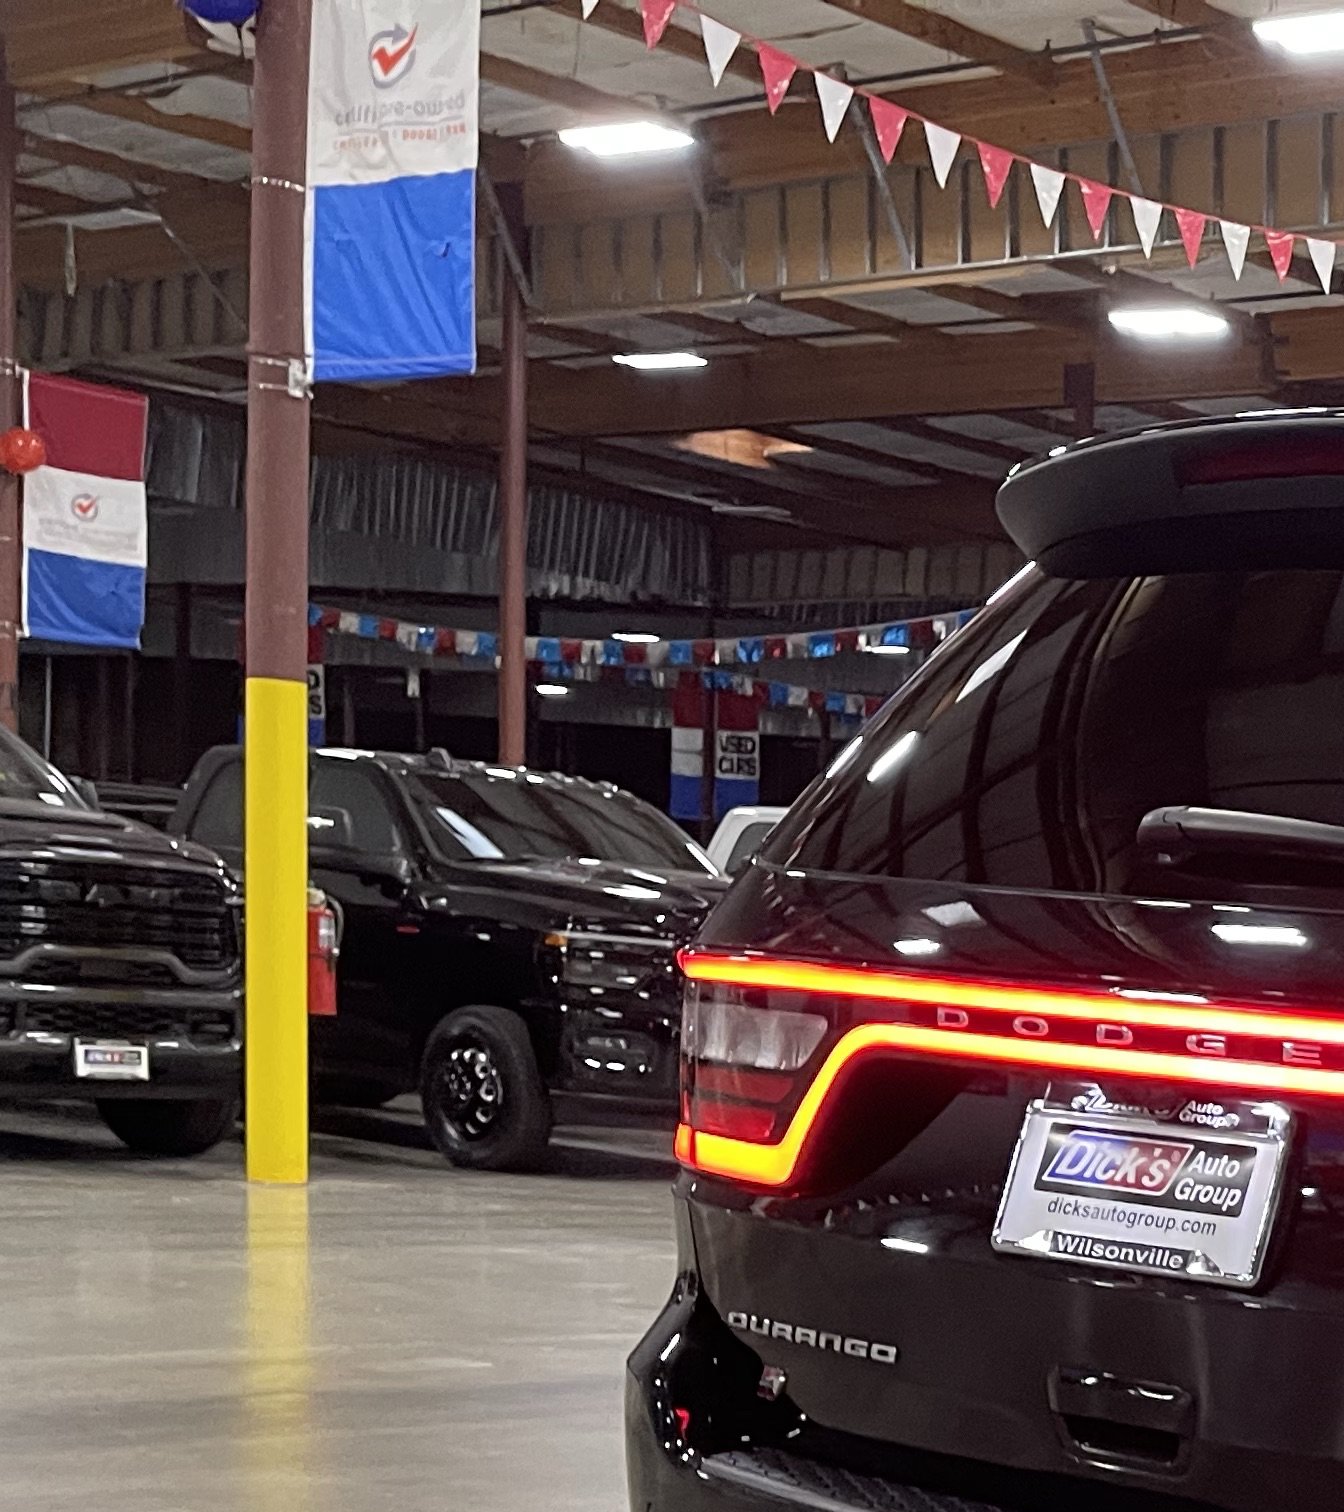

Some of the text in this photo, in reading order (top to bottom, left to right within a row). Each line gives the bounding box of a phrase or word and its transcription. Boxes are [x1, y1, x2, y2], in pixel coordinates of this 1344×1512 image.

[936, 1006, 1322, 1065] DODGE
[1188, 1150, 1240, 1178] Auto
[1175, 1178, 1242, 1212] Group
[1047, 1197, 1217, 1236] dicksautogroup.com
[1057, 1233, 1184, 1269] Wilsonville
[727, 1311, 897, 1364] DURANGO
